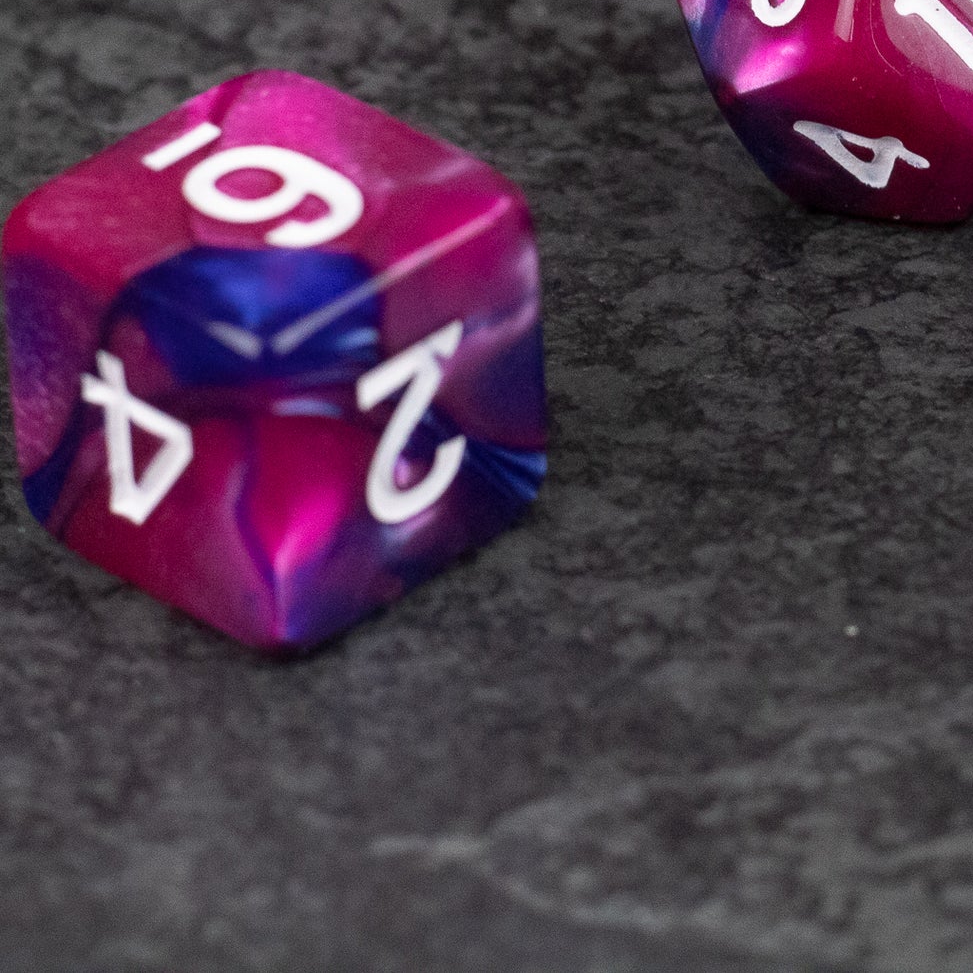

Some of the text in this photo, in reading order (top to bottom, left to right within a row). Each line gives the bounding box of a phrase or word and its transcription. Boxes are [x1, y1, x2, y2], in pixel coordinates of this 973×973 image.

[793, 120, 931, 189] 4
[82, 351, 194, 525] 4
[357, 320, 466, 524] 2
